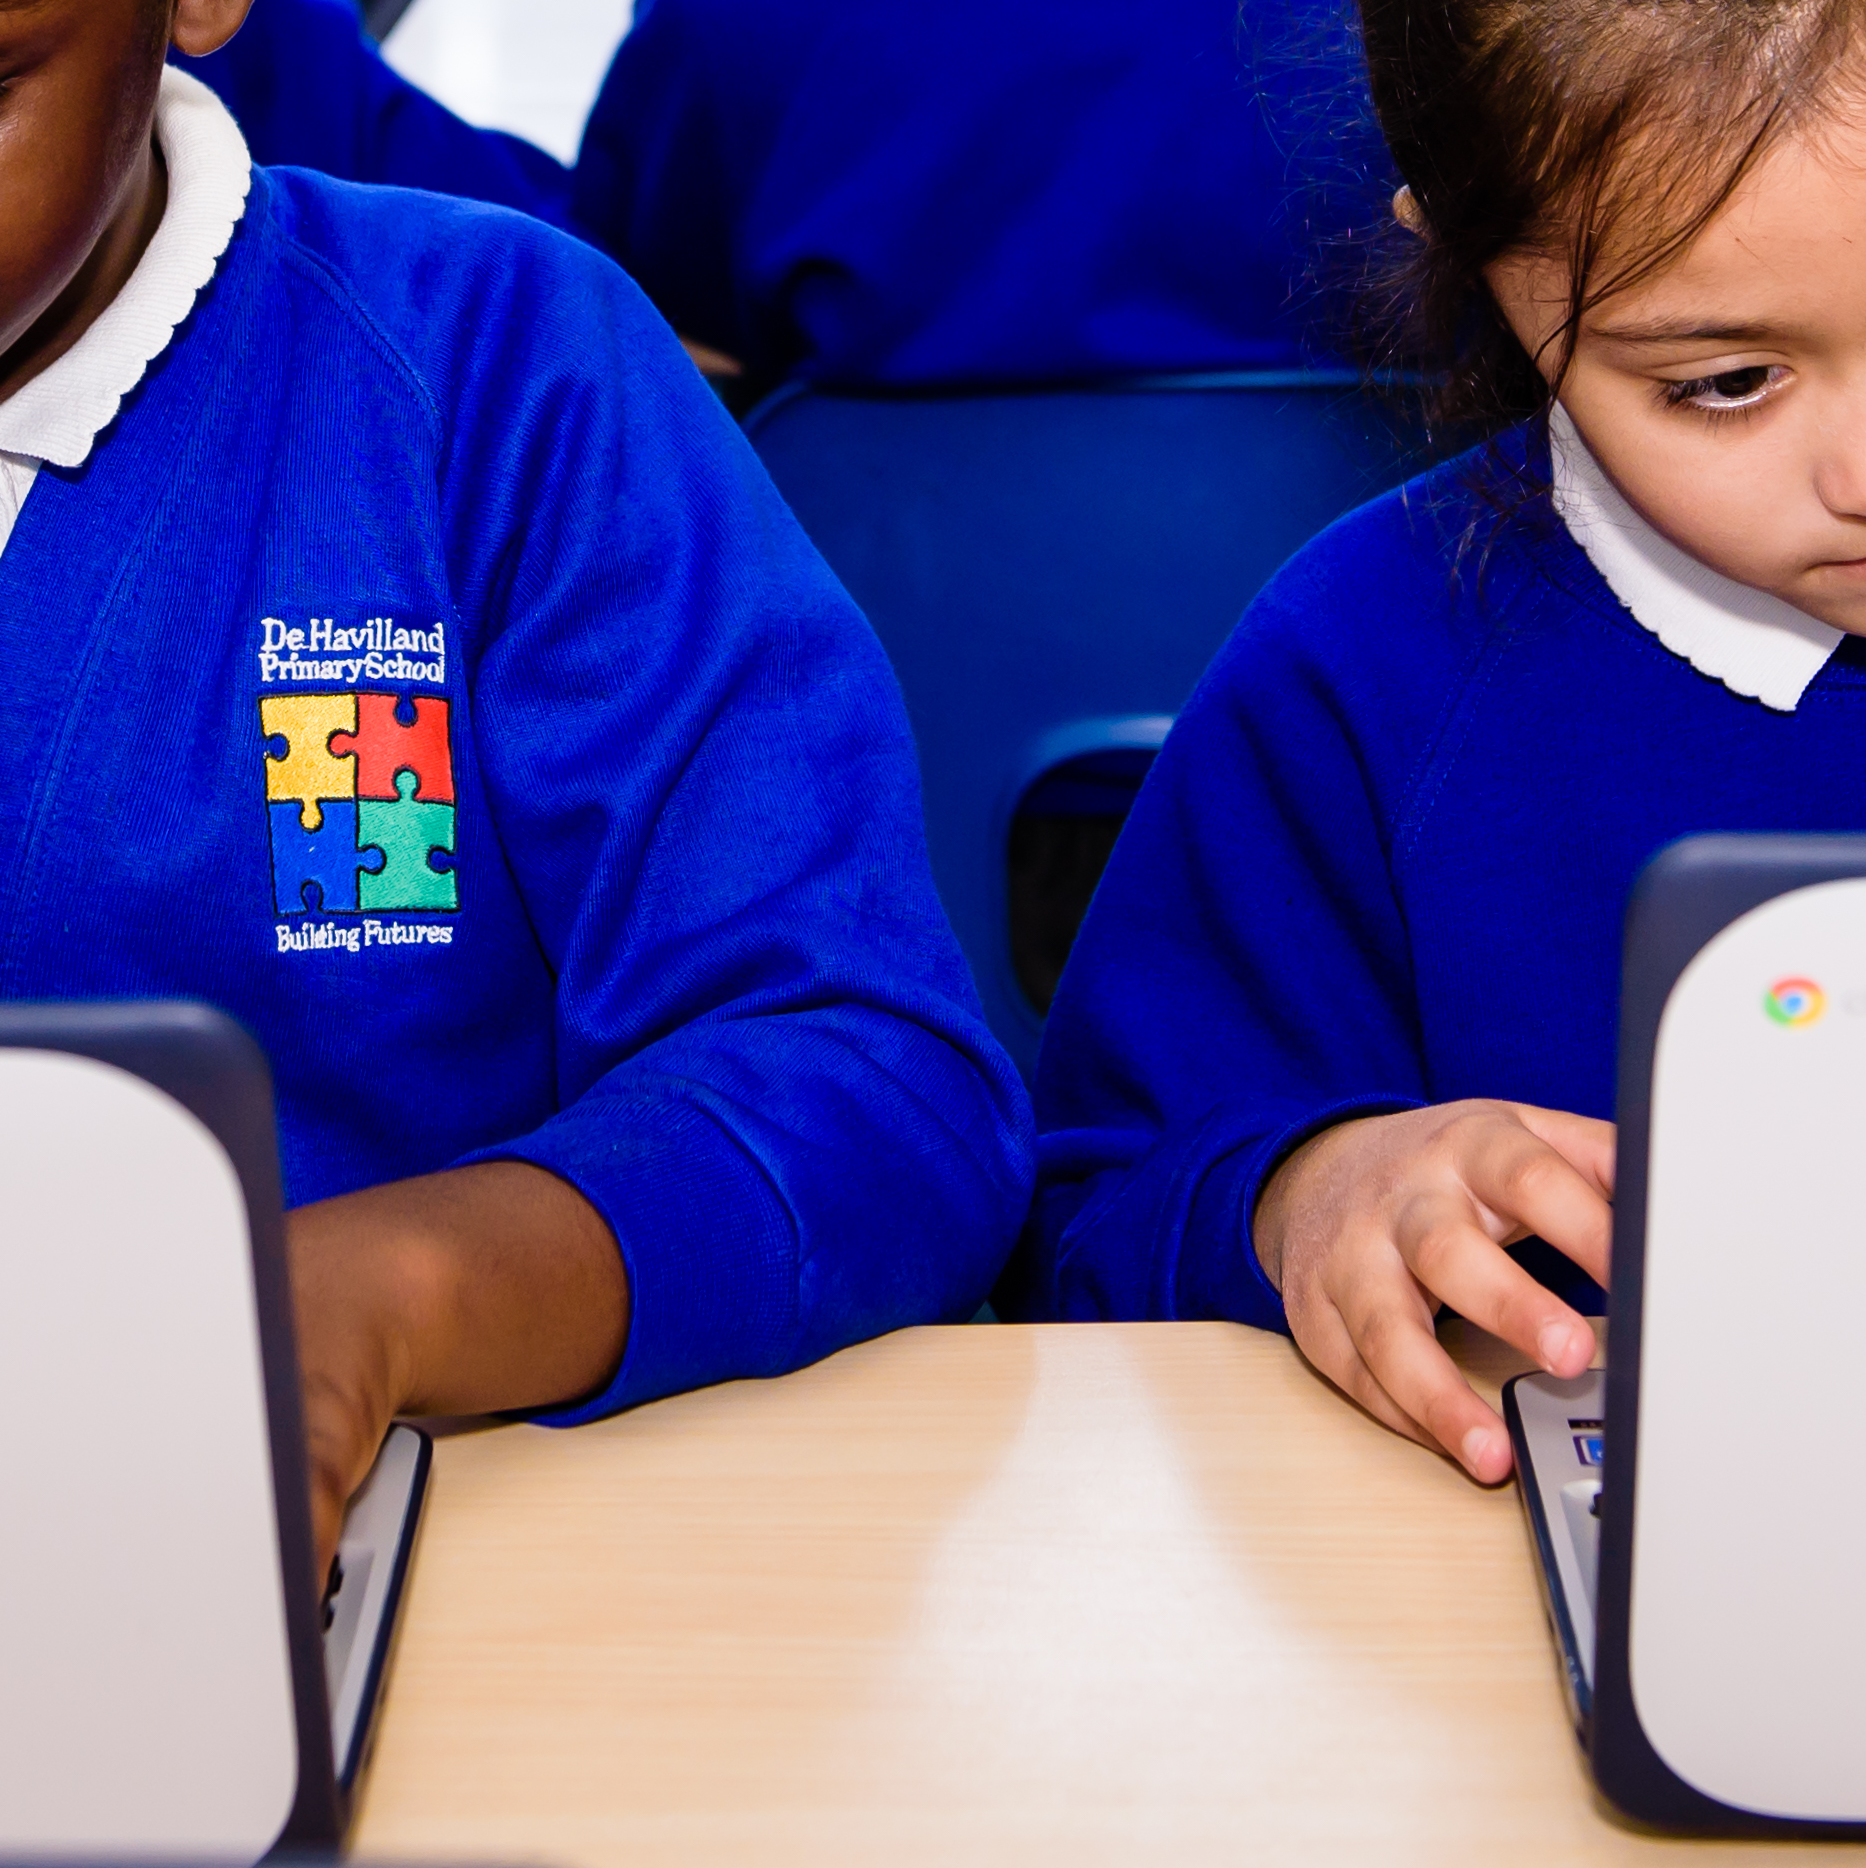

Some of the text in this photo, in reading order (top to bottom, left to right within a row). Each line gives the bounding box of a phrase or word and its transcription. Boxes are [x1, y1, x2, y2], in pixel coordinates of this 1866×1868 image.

[261, 617, 445, 655] De Havilland
[258, 651, 445, 684] Primary School
[275, 919, 454, 953] Building Futures
